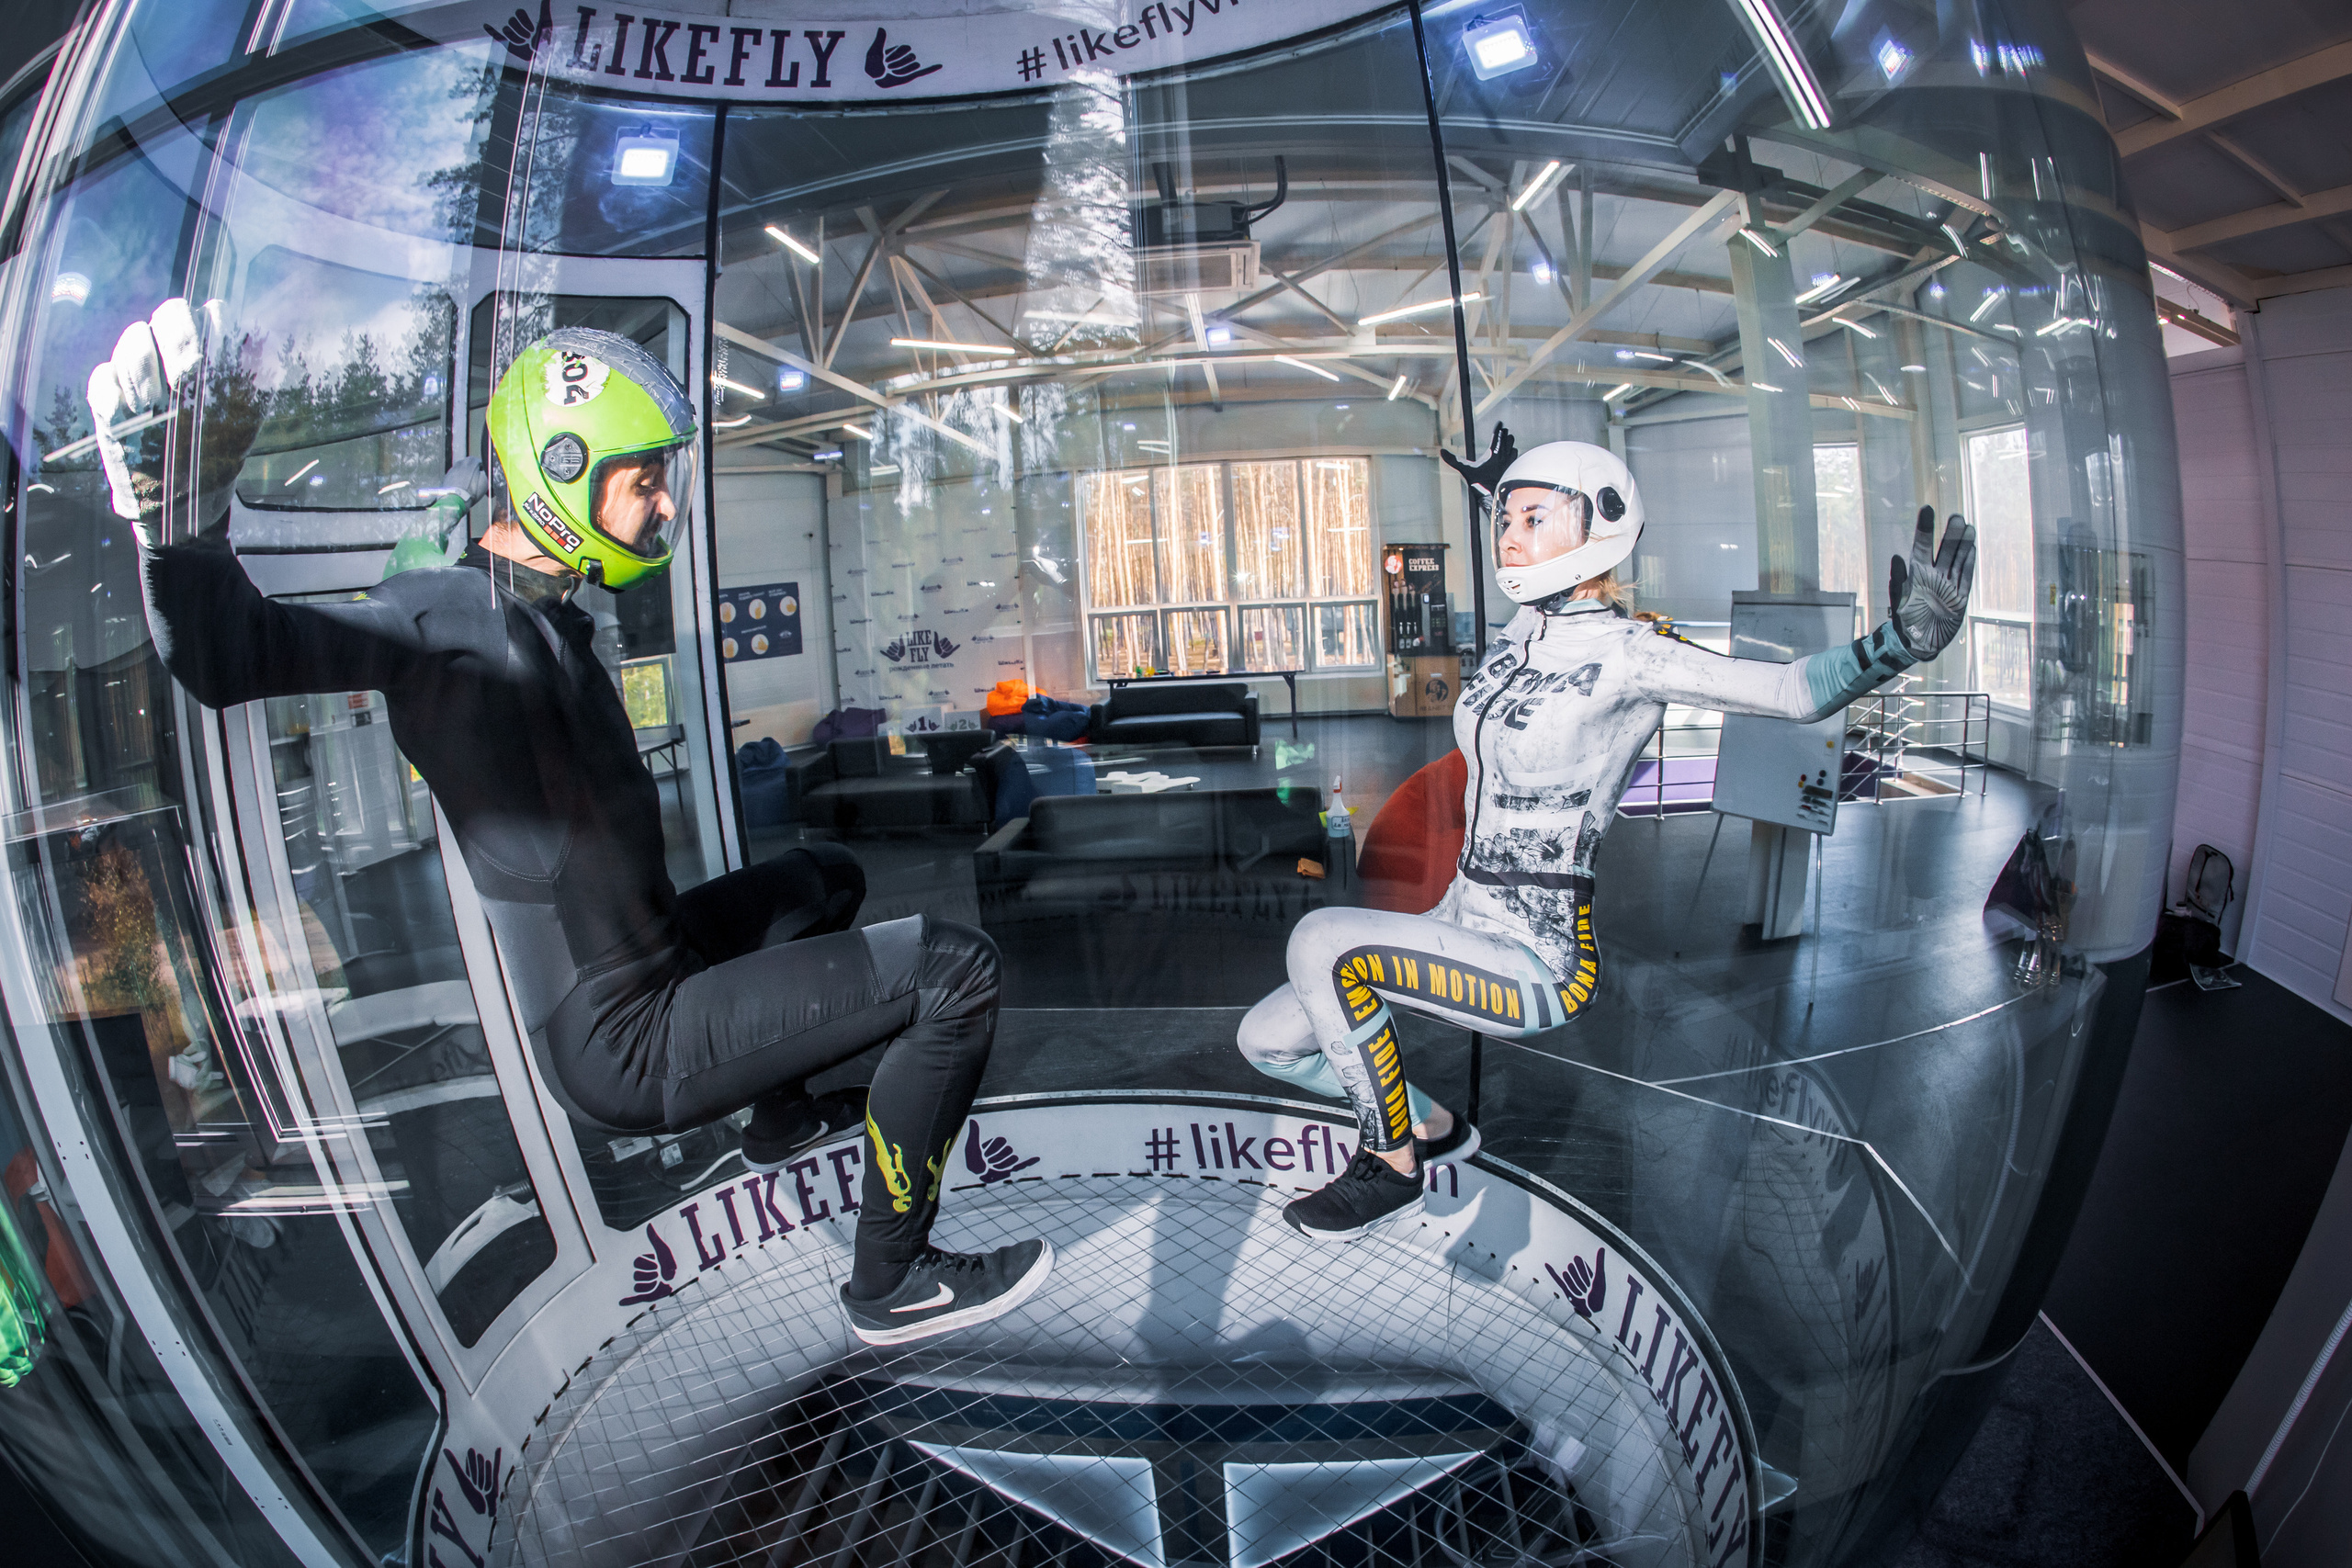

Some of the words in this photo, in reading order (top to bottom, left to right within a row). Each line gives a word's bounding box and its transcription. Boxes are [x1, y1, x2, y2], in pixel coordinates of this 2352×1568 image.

[566, 6, 845, 89] LIKEFLY
[1016, 0, 1239, 83] #likeflyv
[527, 492, 581, 547] NoPro
[906, 629, 932, 647] LIKE
[910, 647, 930, 662] FLY
[918, 716, 927, 731] 1
[958, 718, 968, 730] 2
[1577, 904, 1595, 952] FIDE
[1391, 955, 1419, 990] IN
[1428, 962, 1521, 1020] MOTION
[1559, 958, 1597, 1014] BONA
[1367, 1027, 1401, 1088] FIDE
[1385, 1078, 1409, 1140] BONA
[679, 1145, 862, 1273] LIKEF
[1614, 1273, 1746, 1568] LIKEFLY
